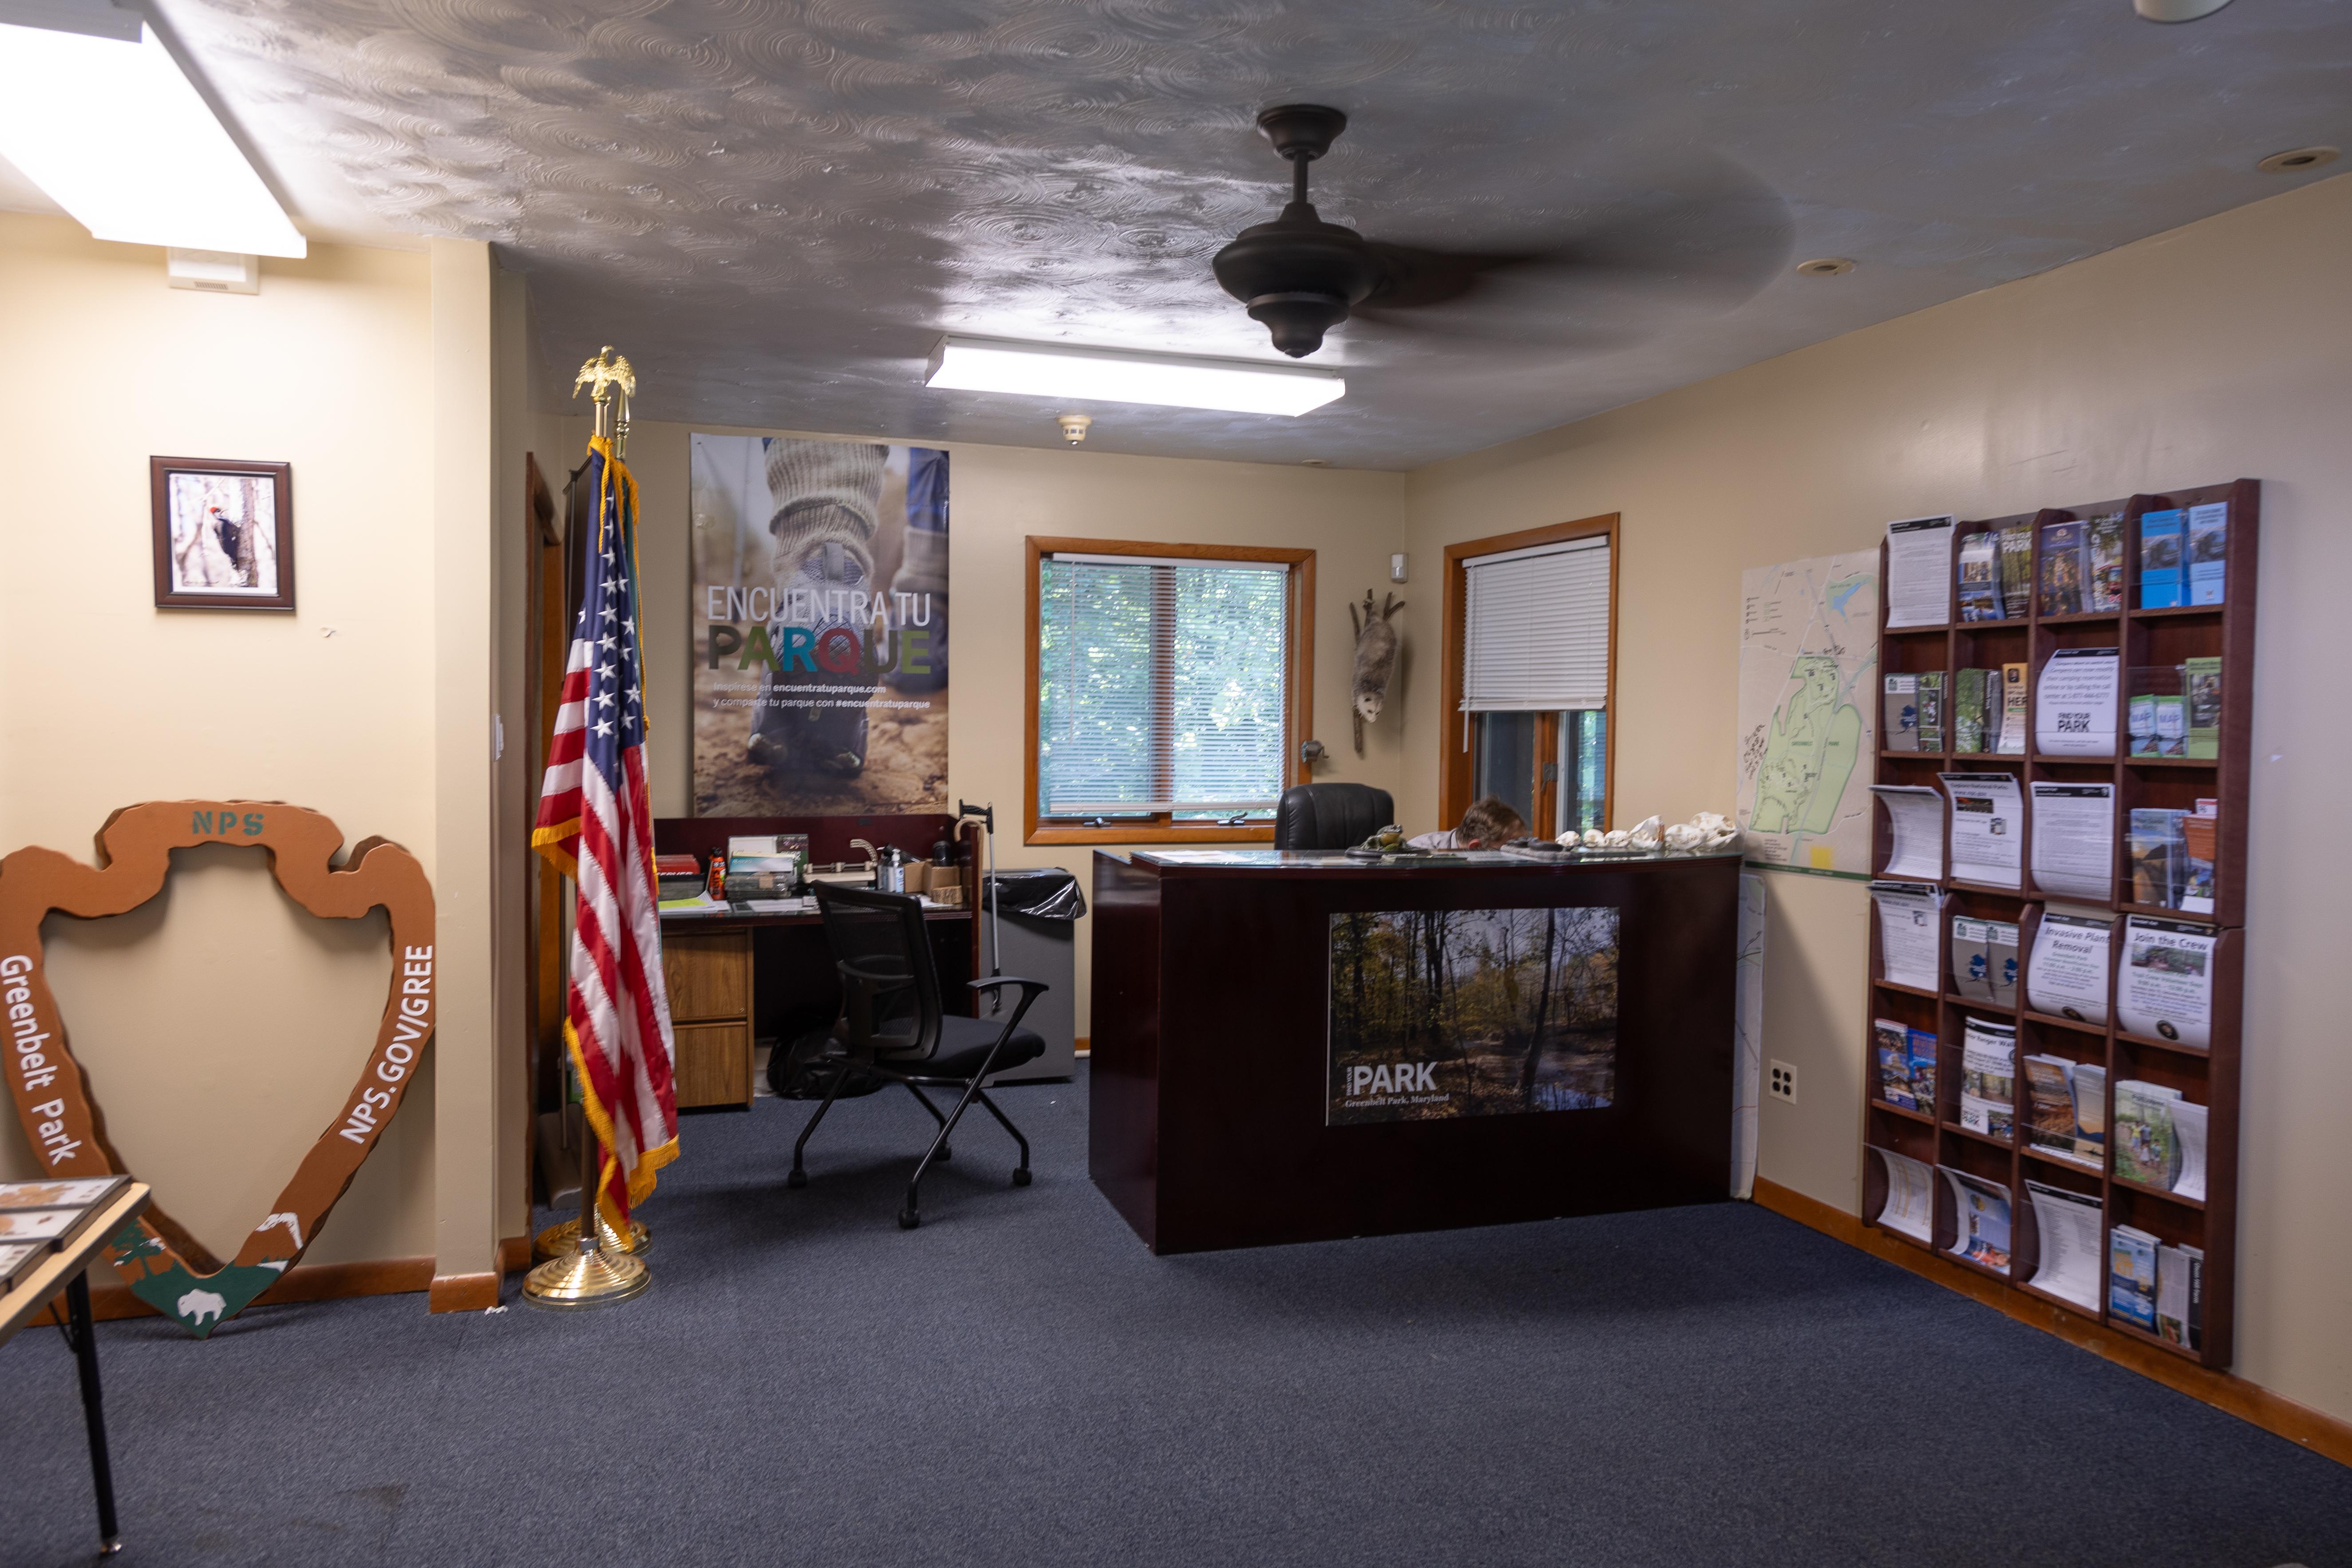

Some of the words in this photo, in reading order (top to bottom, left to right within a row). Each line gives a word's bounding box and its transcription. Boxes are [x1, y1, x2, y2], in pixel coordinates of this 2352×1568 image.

[708, 585, 889, 625] ENCUENTRA
[895, 592, 931, 627] TU
[708, 625, 931, 675] PARQUE
[773, 684, 886, 695] encuentratuparque.com
[721, 699, 767, 708] comparte
[769, 699, 779, 707] tu
[781, 699, 814, 709] parque
[835, 699, 930, 710] #encuentratuparque
[2057, 719, 2091, 733] PARK
[192, 811, 265, 836] NPS
[2045, 927, 2083, 939] Invasive
[2134, 932, 2155, 944] Join
[2158, 935, 2176, 946] the
[2179, 938, 2209, 951] Crew
[2052, 940, 2094, 954] Removal
[339, 944, 434, 1145] NPS.GOV/GREE
[0, 954, 57, 1091] Greenbelt
[32, 1098, 82, 1166] Park
[1353, 1061, 1438, 1096] PARK
[1345, 1097, 1385, 1108] Greenbelt
[1387, 1096, 1410, 1105] Park,
[1410, 1093, 1450, 1104] Maryland
